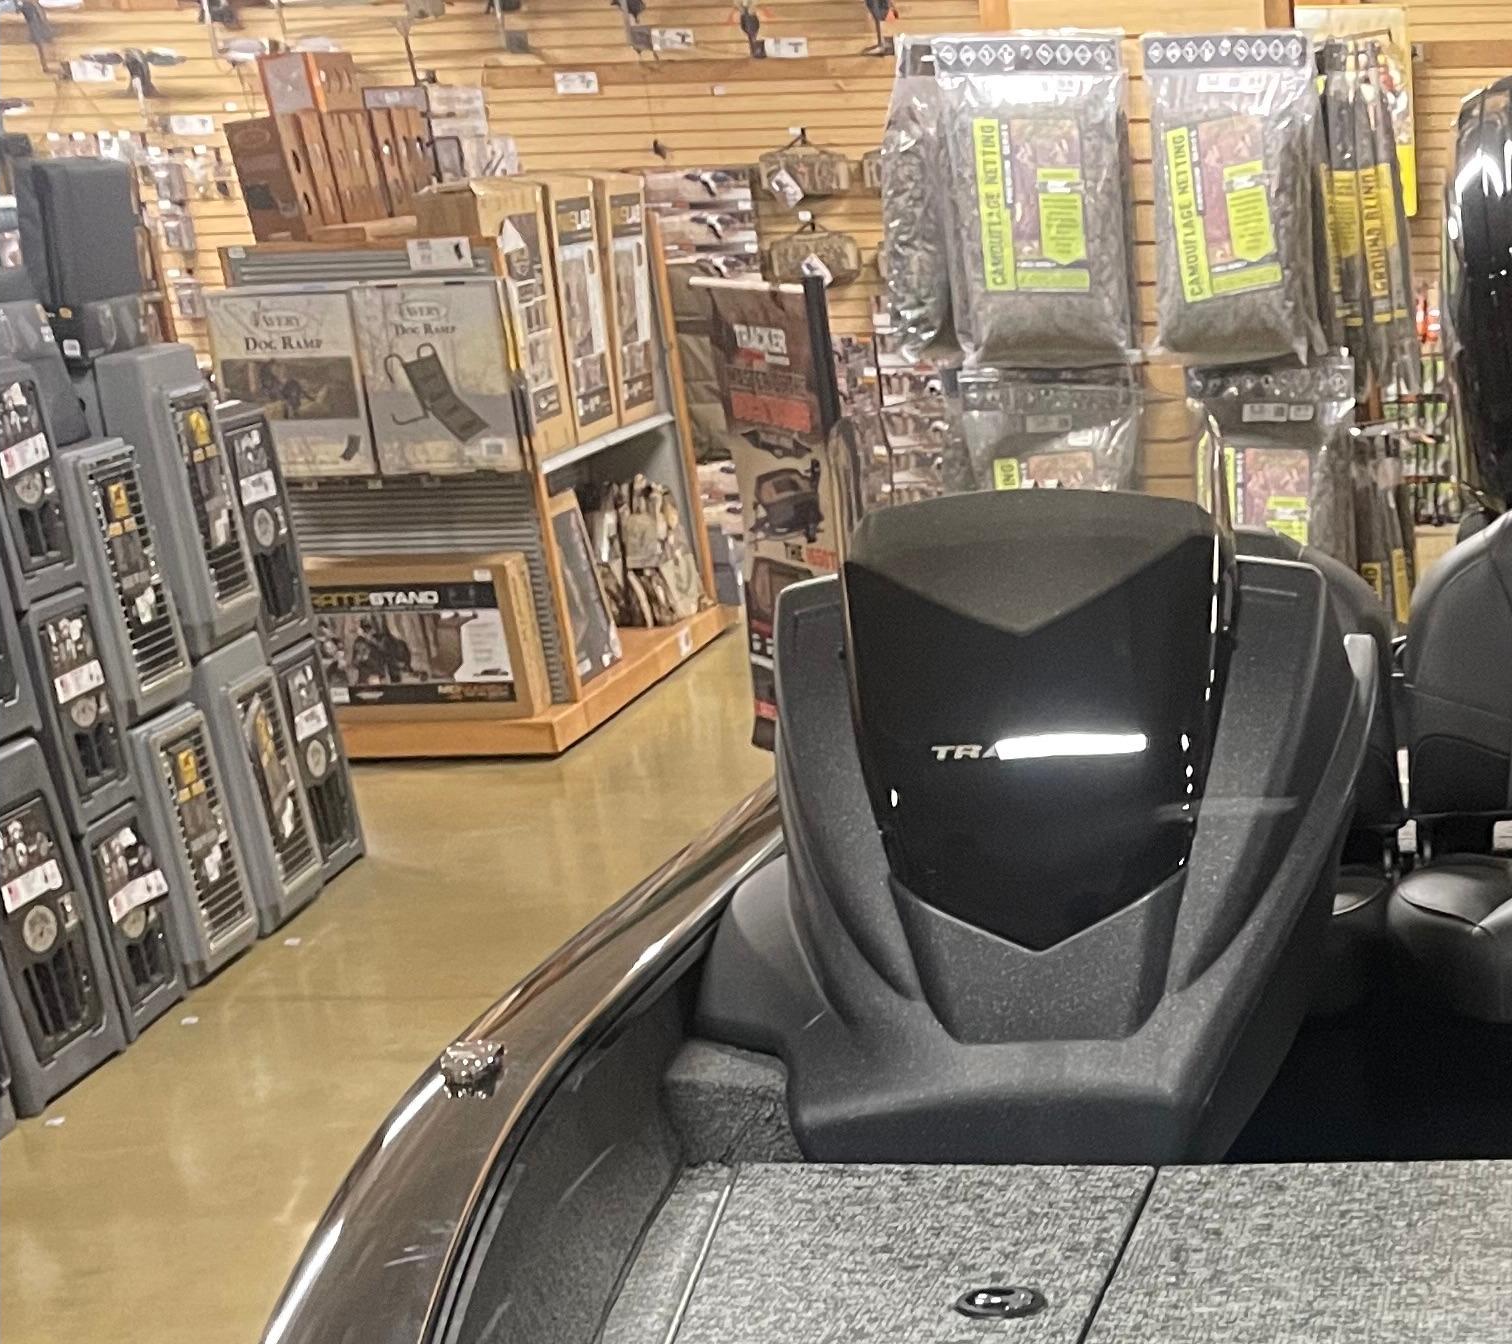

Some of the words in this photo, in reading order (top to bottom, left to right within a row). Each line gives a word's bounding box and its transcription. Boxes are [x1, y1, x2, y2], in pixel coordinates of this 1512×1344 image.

[981, 124, 999, 185] NETTING
[1171, 133, 1189, 197] NETTING
[984, 192, 1008, 287] CAMOUFLAGE
[1176, 200, 1203, 297] CAMOUFLAGE
[281, 335, 323, 351] RAMP
[424, 323, 456, 335] RAMP
